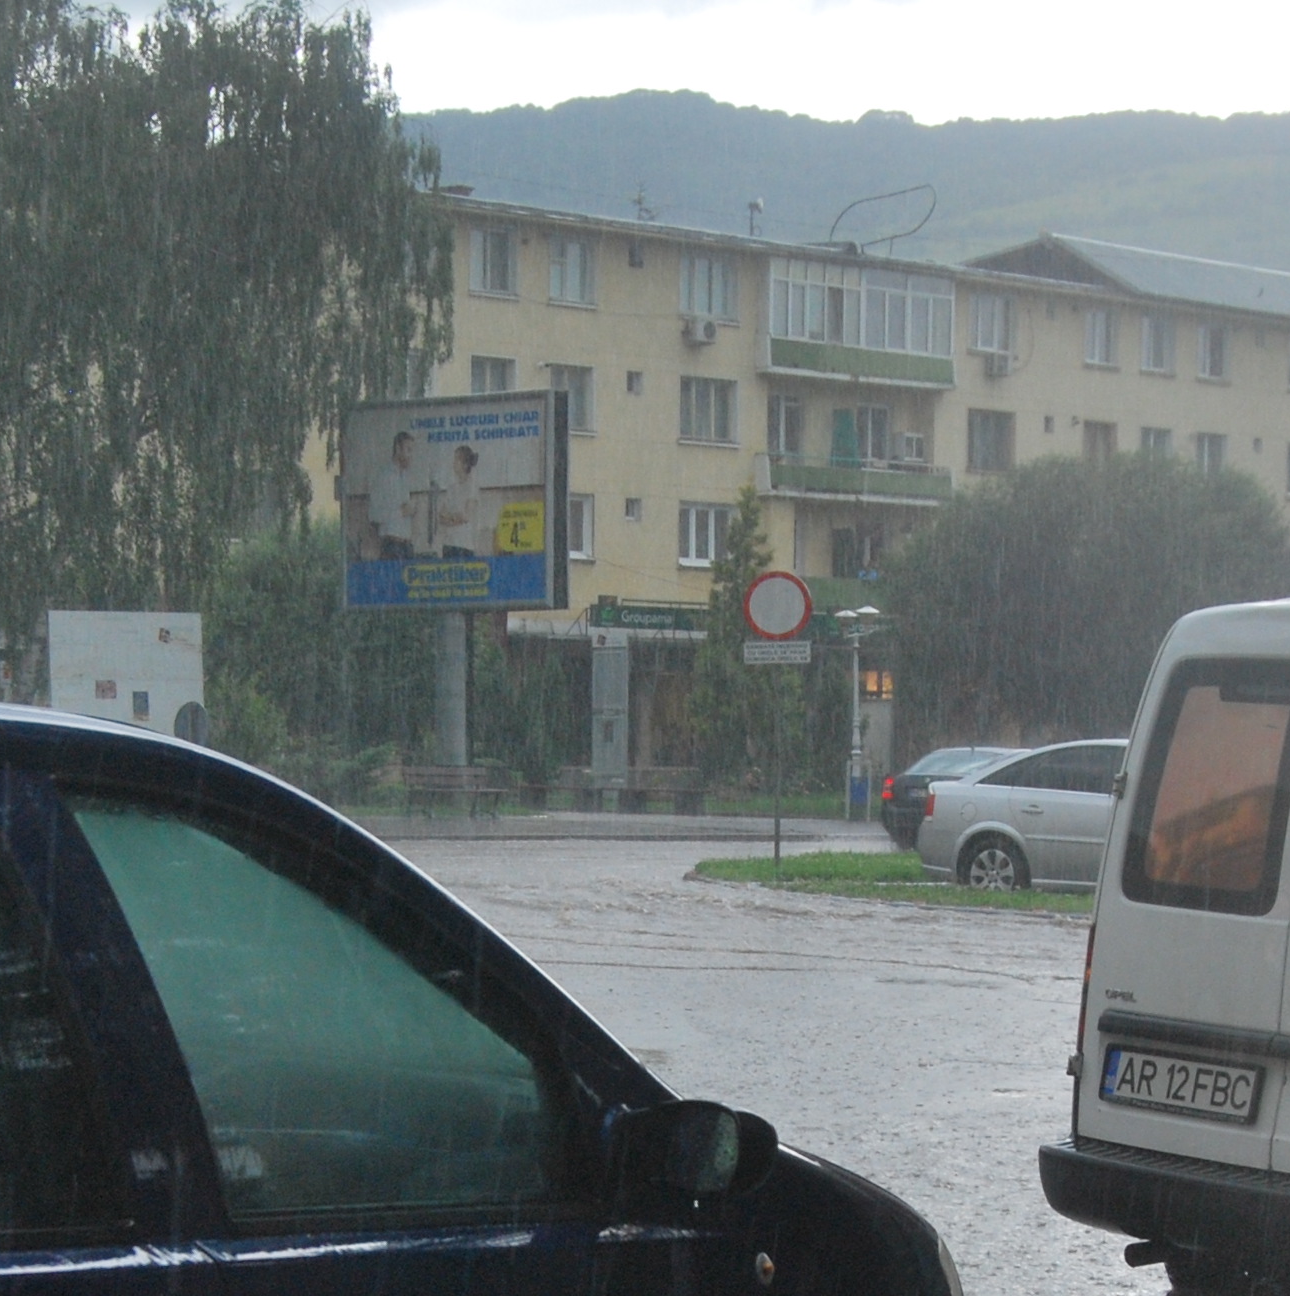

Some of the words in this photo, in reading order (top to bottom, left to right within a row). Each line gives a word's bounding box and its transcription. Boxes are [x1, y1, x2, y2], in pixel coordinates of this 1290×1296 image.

[409, 415, 446, 431] UNELE
[449, 412, 499, 428] LUCRURI
[503, 410, 540, 424] CHIAR
[474, 425, 540, 441] SCHIMBATE
[620, 609, 673, 626] Groupama
[1105, 988, 1137, 1003] OPEL
[1116, 1056, 1158, 1097] AR
[1165, 1063, 1190, 1102] 12
[1191, 1067, 1251, 1110] FBC
